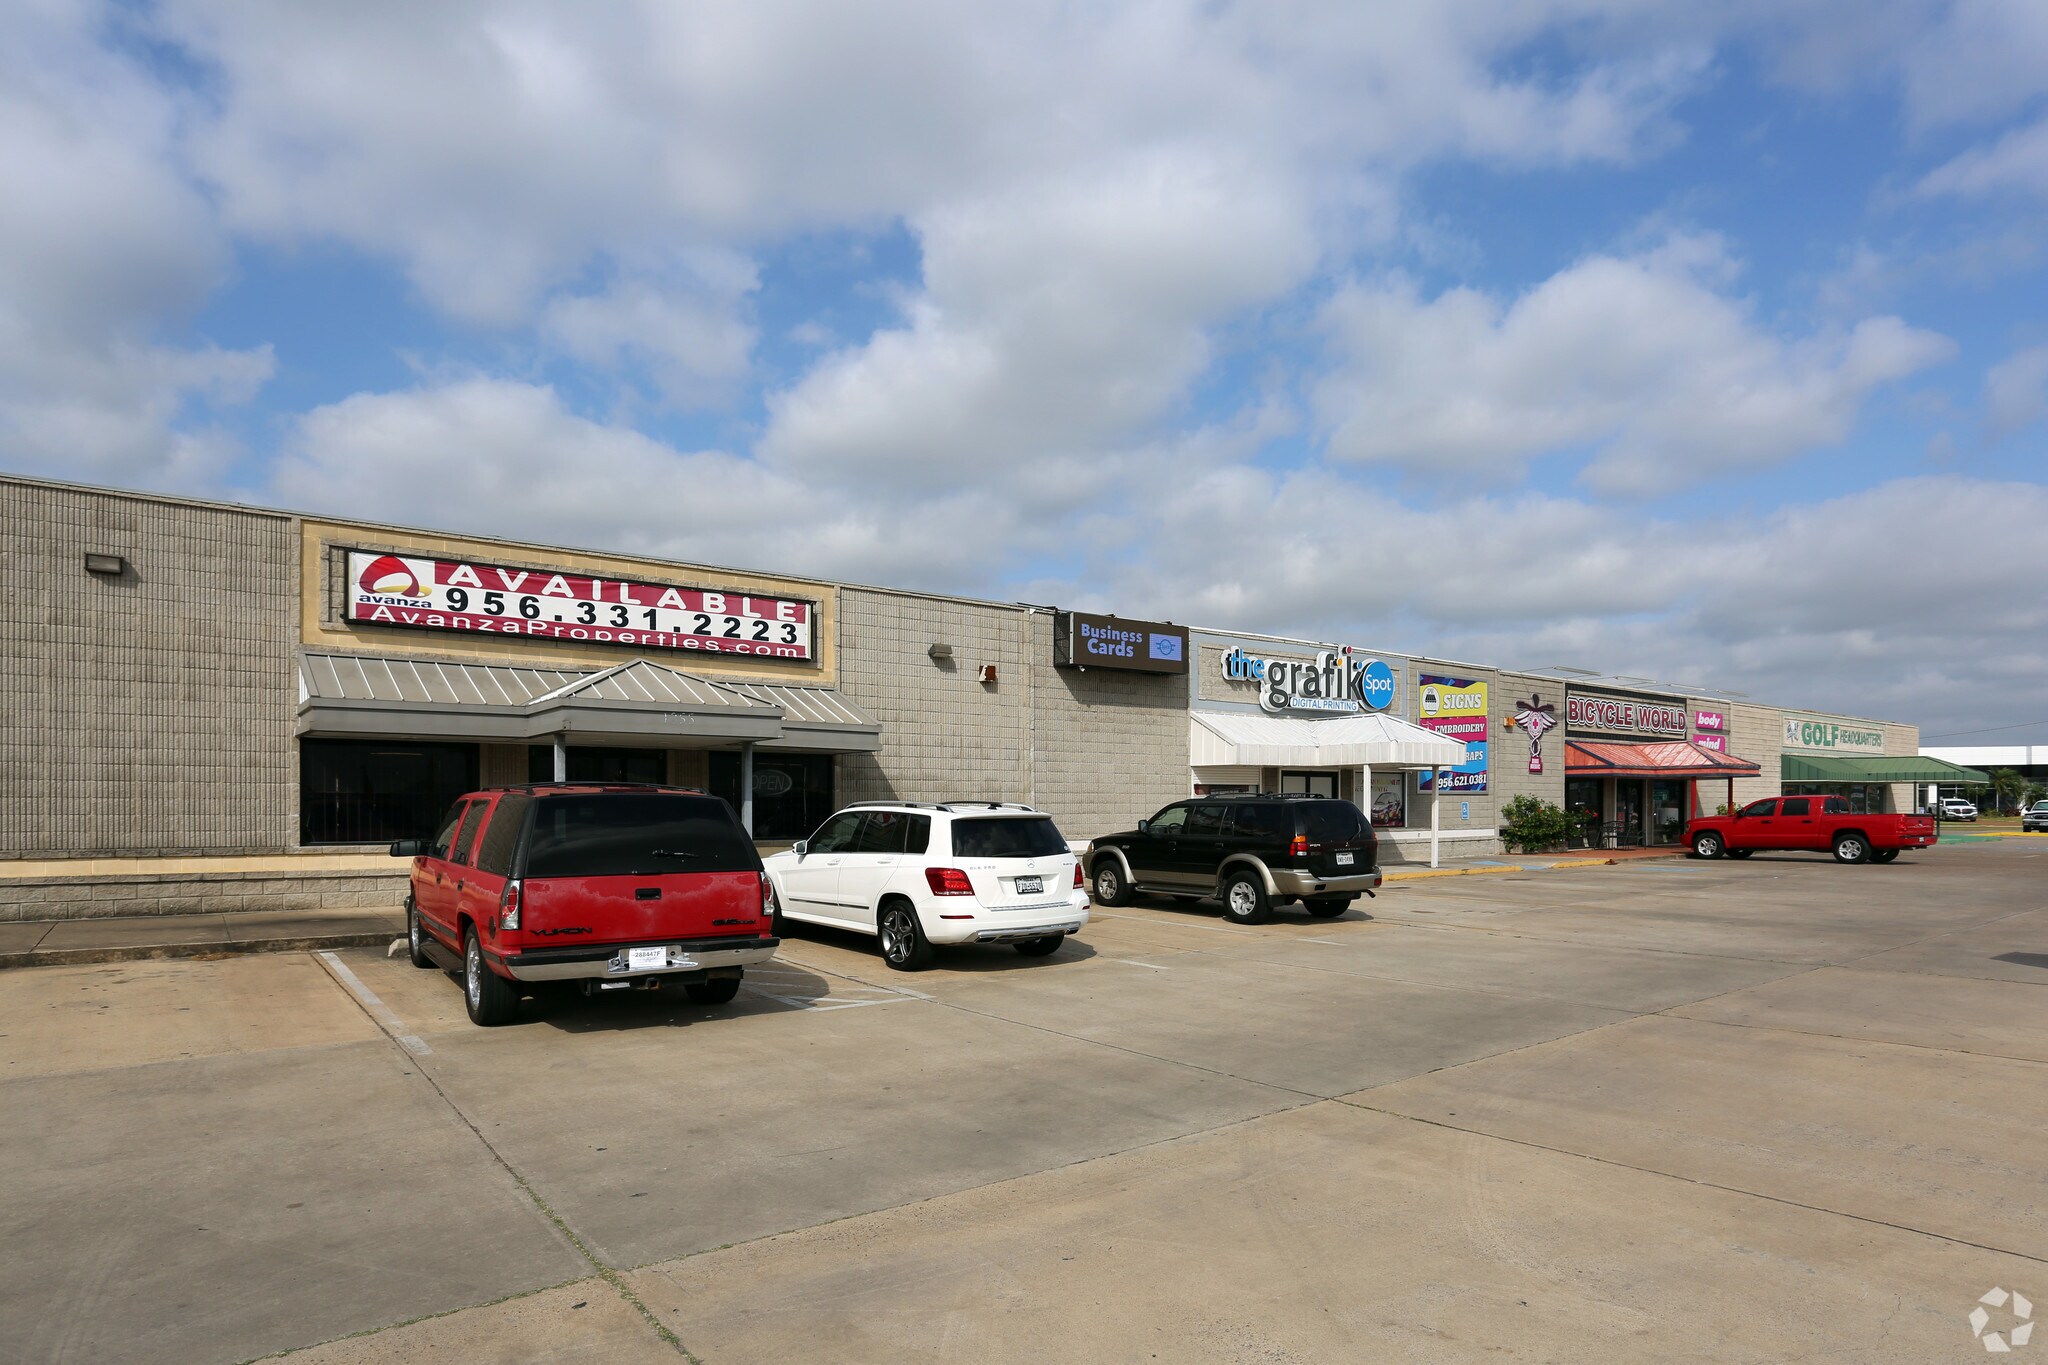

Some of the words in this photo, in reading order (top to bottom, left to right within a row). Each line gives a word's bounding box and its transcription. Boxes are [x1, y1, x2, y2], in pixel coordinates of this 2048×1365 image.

[359, 593, 433, 609] avanza
[447, 565, 797, 622] AVAILABLE
[446, 588, 798, 644] 956.331.2223
[370, 605, 798, 657] AvanzaProperties.com
[1081, 623, 1143, 643] Business
[1087, 639, 1134, 657] Cards
[1230, 648, 1265, 678] the
[1268, 650, 1364, 708] grafik
[1365, 674, 1392, 694] Spot
[1291, 698, 1322, 709] DIGITAL
[1322, 701, 1357, 711] PRINTING
[1443, 694, 1482, 709] SIGNS
[1567, 699, 1634, 728] BICYCLE
[1639, 706, 1686, 732] WORLD
[1698, 712, 1720, 728] body
[1434, 723, 1485, 734] EMBROIDERY
[1801, 722, 1839, 746] GOLF
[1840, 729, 1882, 747] HEADQUARTERS
[1466, 751, 1483, 761] RAPS
[1438, 774, 1486, 788] 956.621.0381
[531, 927, 592, 935] YUKON
